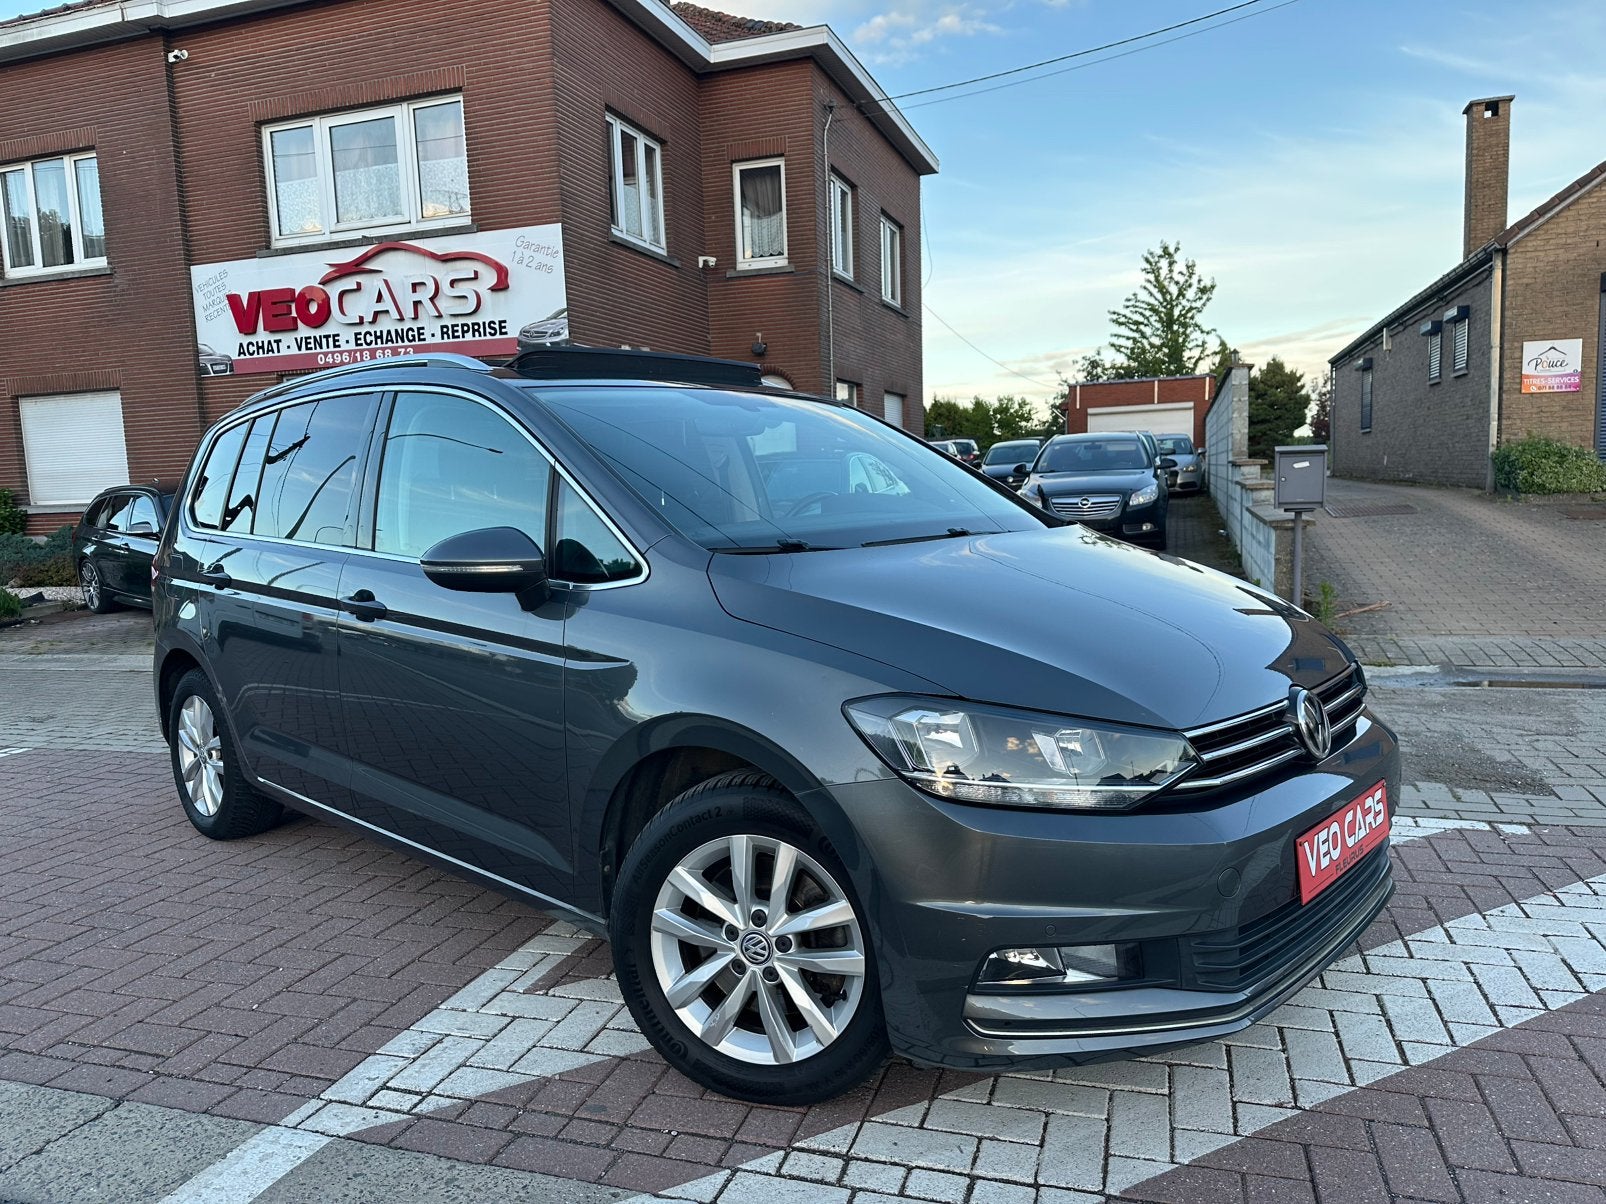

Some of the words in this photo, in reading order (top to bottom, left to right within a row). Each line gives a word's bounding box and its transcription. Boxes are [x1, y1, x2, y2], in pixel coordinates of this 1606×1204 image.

[515, 235, 559, 259] Garantie
[511, 250, 517, 263] 1
[517, 251, 524, 265] à
[525, 255, 535, 269] 2
[534, 261, 554, 274] ans
[202, 290, 232, 313] MARQU
[203, 282, 227, 301] TOUTES
[204, 304, 231, 323] RECENT
[237, 338, 283, 357] ACHAT
[294, 333, 341, 352] VENTE
[353, 326, 427, 348] ECHANGE
[439, 319, 508, 341] REPRISE
[317, 350, 371, 365] 0496/18
[375, 349, 392, 359] 68
[1527, 357, 1569, 371] Pouce
[1523, 376, 1579, 385] TITRES-SERVICES
[712, 806, 723, 818] 2
[1303, 821, 1342, 878] VEO
[1344, 788, 1385, 849] CARS
[1335, 845, 1364, 875] FLEURUS
